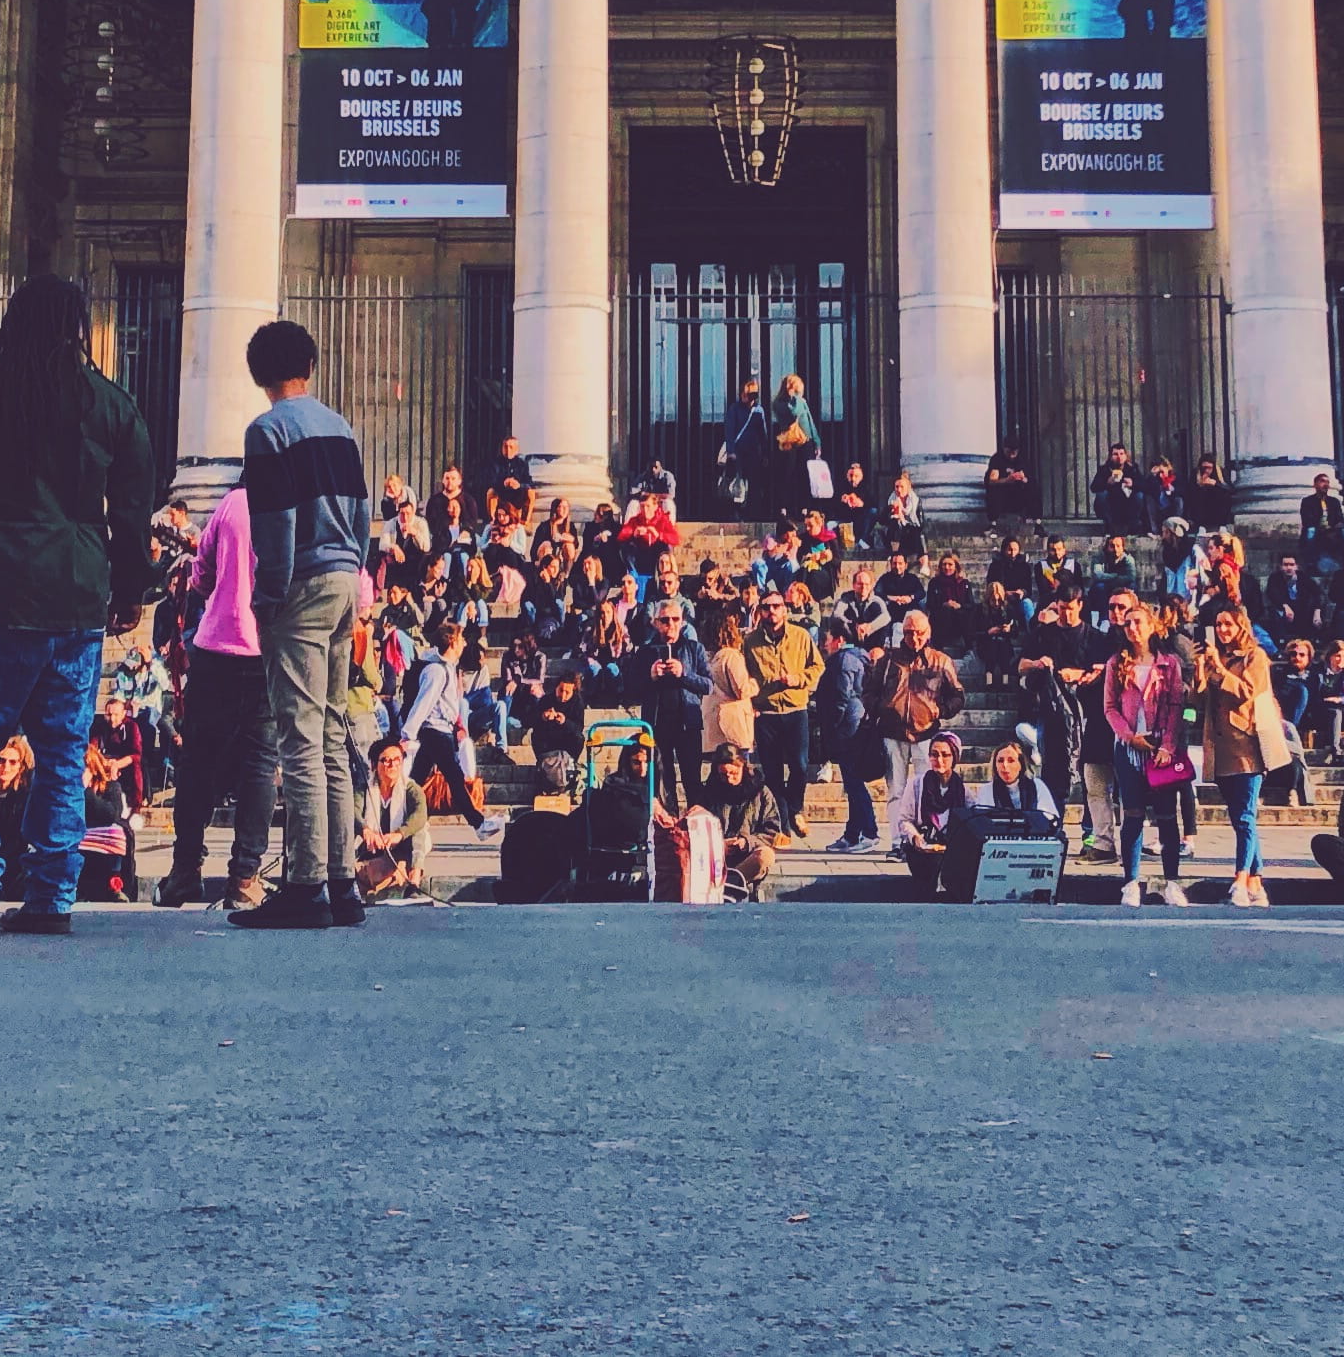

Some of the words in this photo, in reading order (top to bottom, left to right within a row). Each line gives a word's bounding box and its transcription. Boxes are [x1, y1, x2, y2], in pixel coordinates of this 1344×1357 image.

[326, 21, 360, 31] DIGITAL
[363, 21, 381, 31] ART
[326, 32, 380, 43] EXPERIENCE
[341, 68, 361, 87] 10
[364, 69, 394, 87] OCT
[410, 69, 430, 87] 06
[433, 69, 463, 87] JAN
[1039, 71, 1060, 90] 10
[1062, 72, 1093, 90] OCT
[1109, 72, 1130, 90] 06
[1133, 72, 1163, 90] JAN
[340, 99, 401, 117] BOURSE
[412, 99, 463, 117] BEURS
[1040, 103, 1101, 121] BOURSE
[1112, 103, 1165, 121] BEURS
[362, 119, 441, 137] BRUSSELS
[1062, 122, 1143, 141] BRUSSELS
[339, 149, 463, 168] EXPOVANGOGH.BE
[1041, 153, 1165, 172] EXPOVANGOGH.BE
